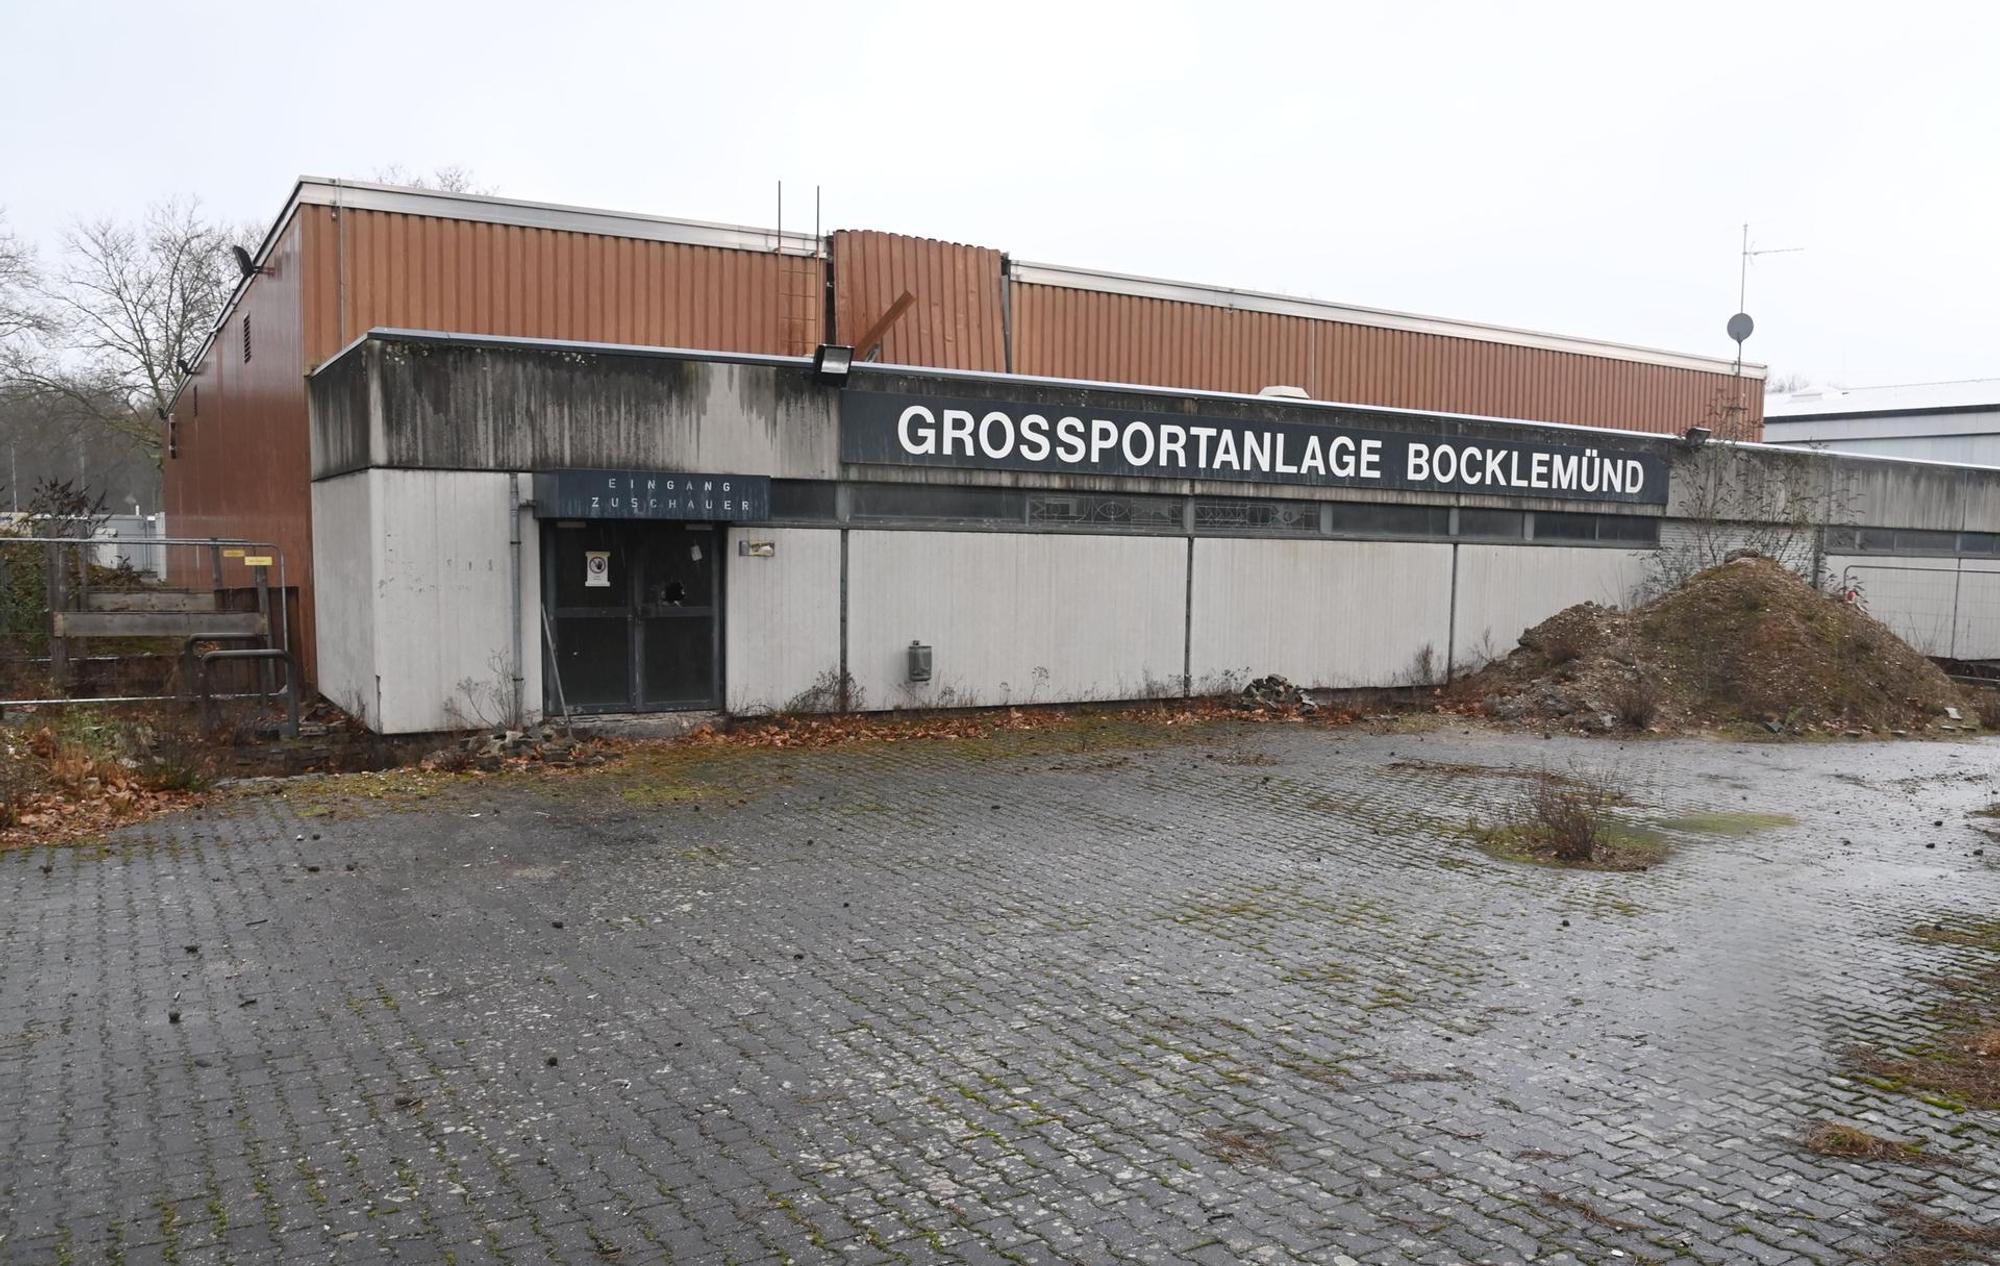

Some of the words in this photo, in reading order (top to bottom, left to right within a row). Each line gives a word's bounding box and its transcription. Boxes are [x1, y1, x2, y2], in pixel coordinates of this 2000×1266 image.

[896, 405, 1383, 479] GROSSPORTANLAGE
[1406, 442, 1645, 494] BOCKLEMÜND
[608, 478, 731, 492] EINGANG
[591, 496, 750, 511] ZUSCHAUER
